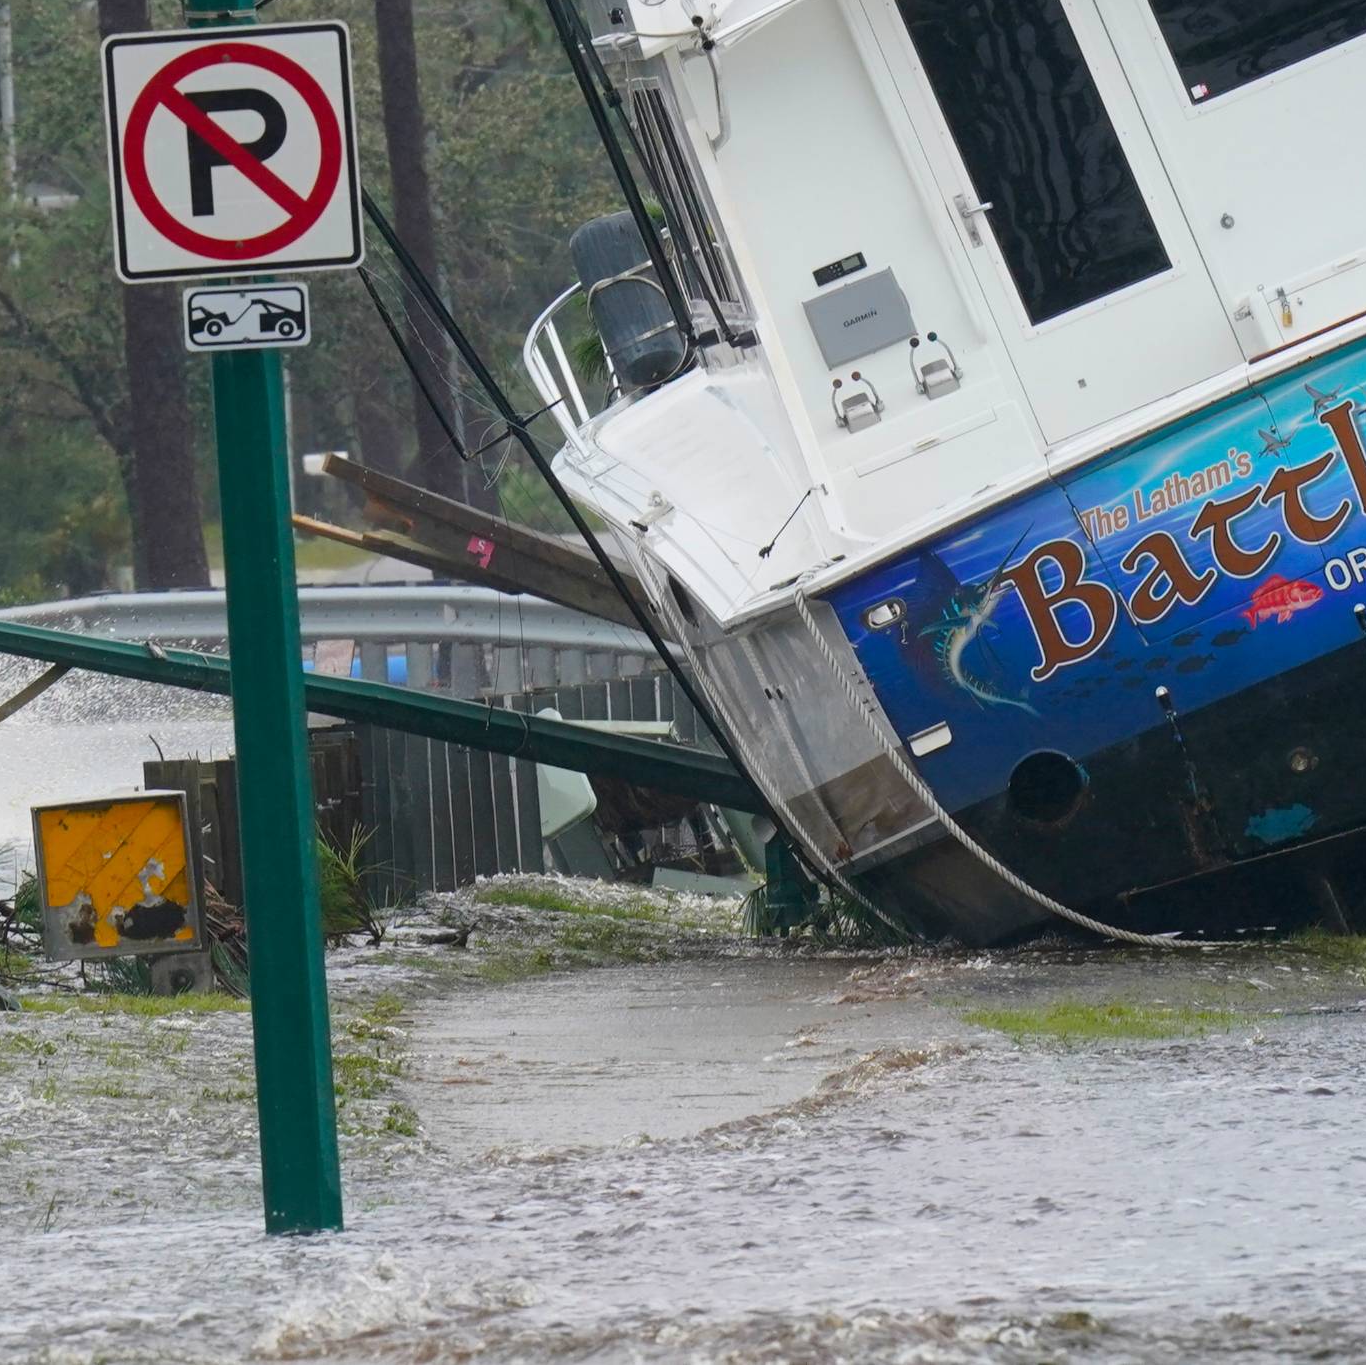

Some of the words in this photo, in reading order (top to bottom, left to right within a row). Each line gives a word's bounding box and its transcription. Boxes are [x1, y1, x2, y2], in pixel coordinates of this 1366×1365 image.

[183, 87, 288, 218] P
[843, 310, 877, 328] GARMIN
[1080, 502, 1130, 542] The
[1133, 448, 1253, 523] Latham's
